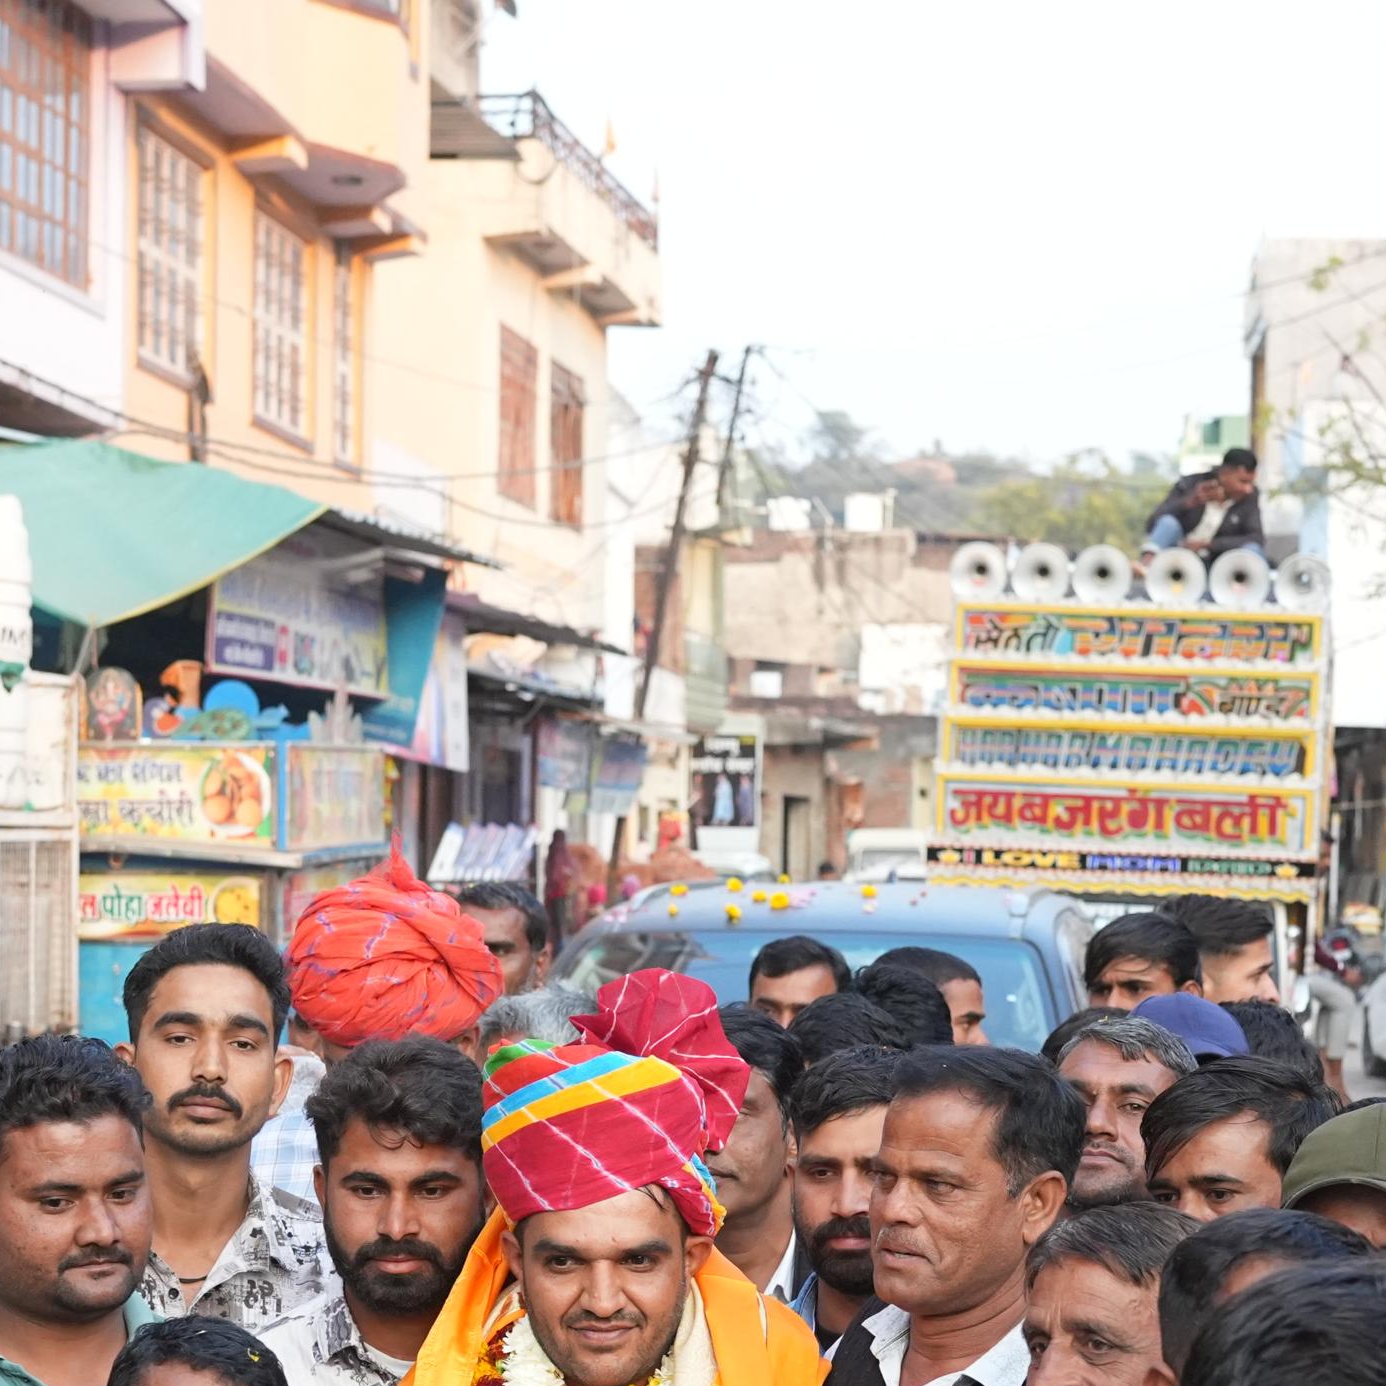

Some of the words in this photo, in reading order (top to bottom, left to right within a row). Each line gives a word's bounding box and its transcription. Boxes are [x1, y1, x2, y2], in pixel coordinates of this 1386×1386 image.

[1174, 793, 1290, 841] बली
[982, 852, 1081, 869] LOVE
[1086, 854, 1181, 872] MOM
[102, 884, 143, 918] पोहा
